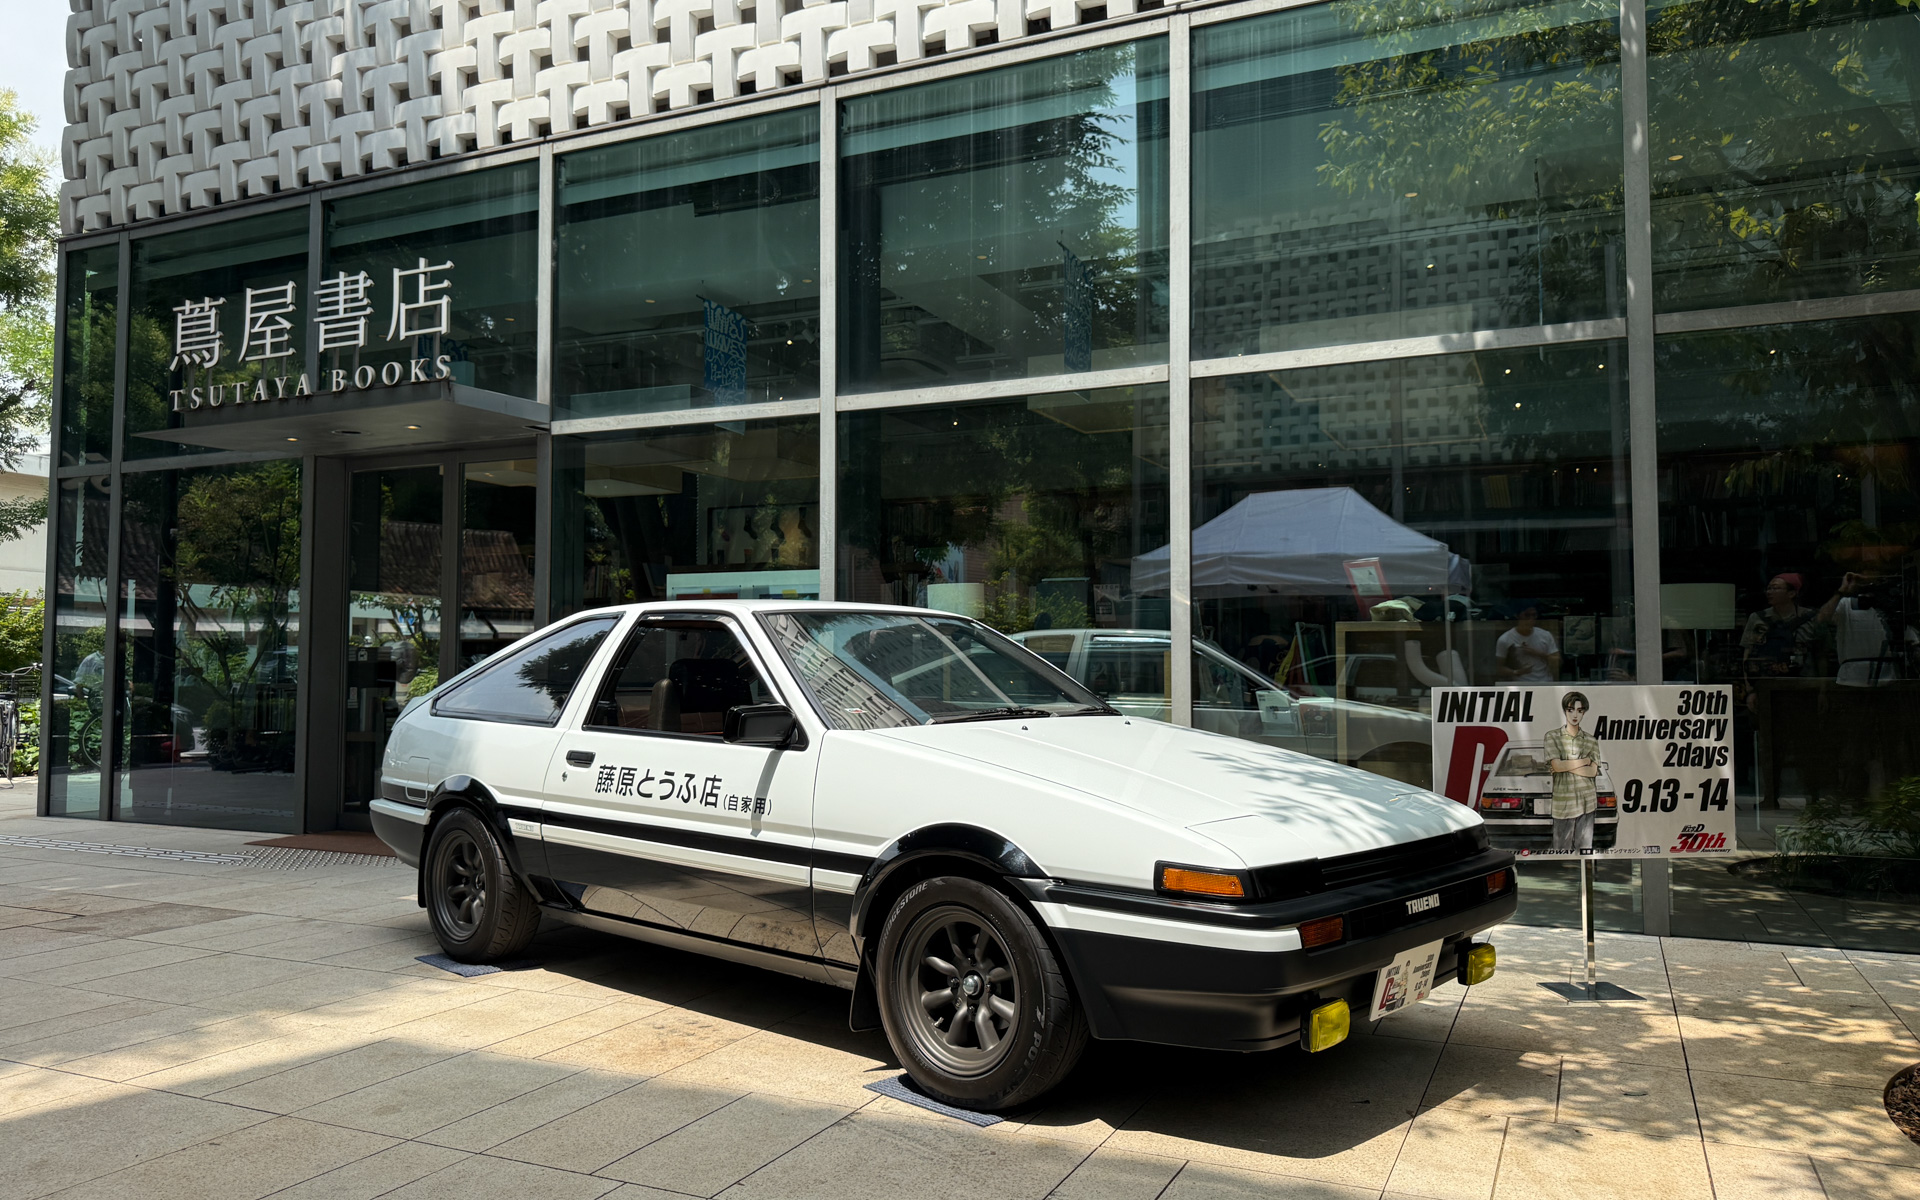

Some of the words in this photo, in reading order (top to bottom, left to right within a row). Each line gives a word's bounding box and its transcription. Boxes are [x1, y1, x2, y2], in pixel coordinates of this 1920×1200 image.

[169, 257, 455, 372] 蔦屋書店
[170, 373, 313, 412] TSUTAYA
[331, 355, 451, 392] BOOKS
[1437, 691, 1534, 723] INITIAL
[1677, 690, 1728, 716] 30th
[1594, 716, 1728, 742] Anniversary
[1663, 742, 1728, 769] 2days
[595, 765, 722, 809] 藤原とうふ店
[723, 794, 772, 815] (自家用)
[1522, 848, 1575, 856] SPEEDWAY
[1670, 832, 1726, 853] 30th
[1405, 893, 1440, 915] TRUENO
